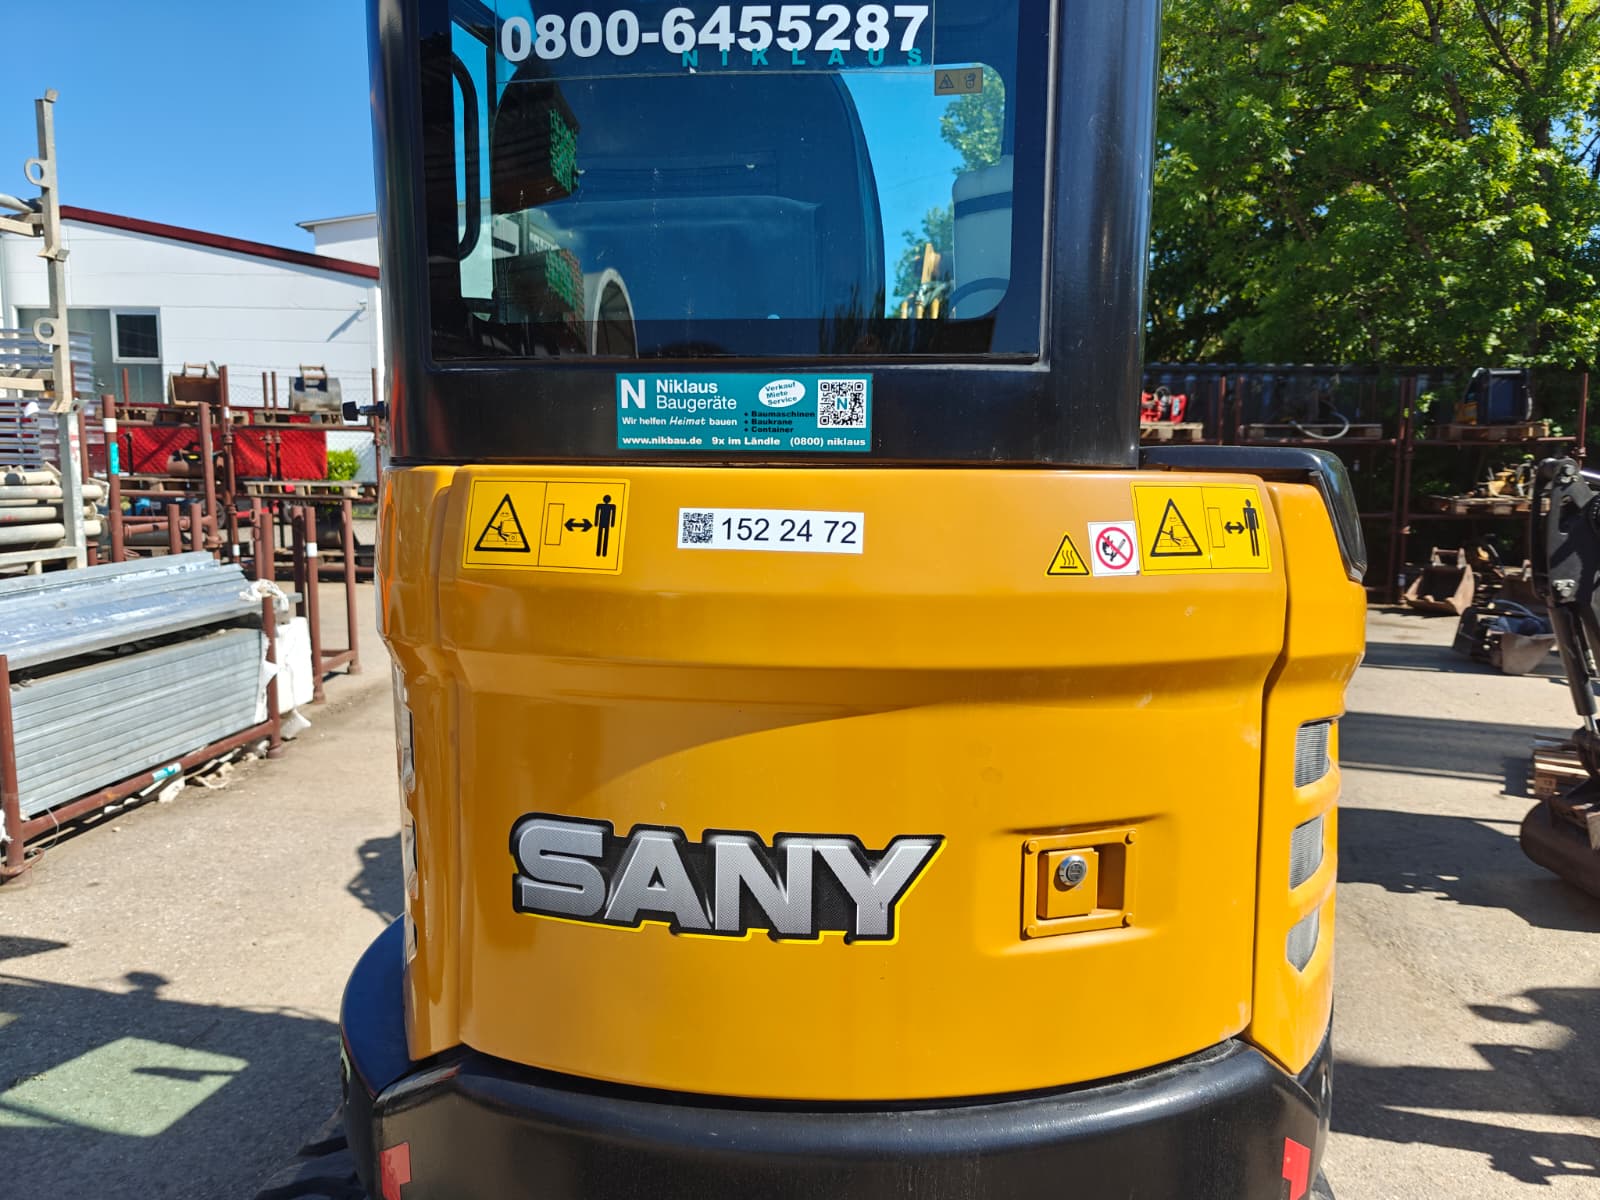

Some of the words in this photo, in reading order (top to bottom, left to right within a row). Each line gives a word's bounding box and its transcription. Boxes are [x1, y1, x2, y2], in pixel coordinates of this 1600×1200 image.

[500, 4, 929, 61] 0800-6455287
[681, 47, 923, 67] NIKLAUS
[621, 378, 646, 409] N
[656, 379, 718, 394] Niklaus
[765, 381, 796, 392] Verkauf
[766, 391, 788, 399] Miete
[767, 396, 797, 406] Service
[656, 395, 737, 413] Baugeräte
[622, 416, 637, 425] Wir
[639, 416, 666, 425] helfen
[669, 416, 706, 426] Heimat
[709, 417, 738, 426] bauen
[622, 436, 703, 445] www.nikbau.de
[711, 436, 725, 445] 9x
[727, 436, 741, 445] im
[744, 436, 781, 446] Ländle
[790, 437, 824, 447] (0800)
[826, 437, 866, 446] niklaus
[722, 517, 770, 541] 152
[779, 519, 813, 542] 24
[824, 520, 857, 544] 72
[514, 815, 940, 938] SANY
